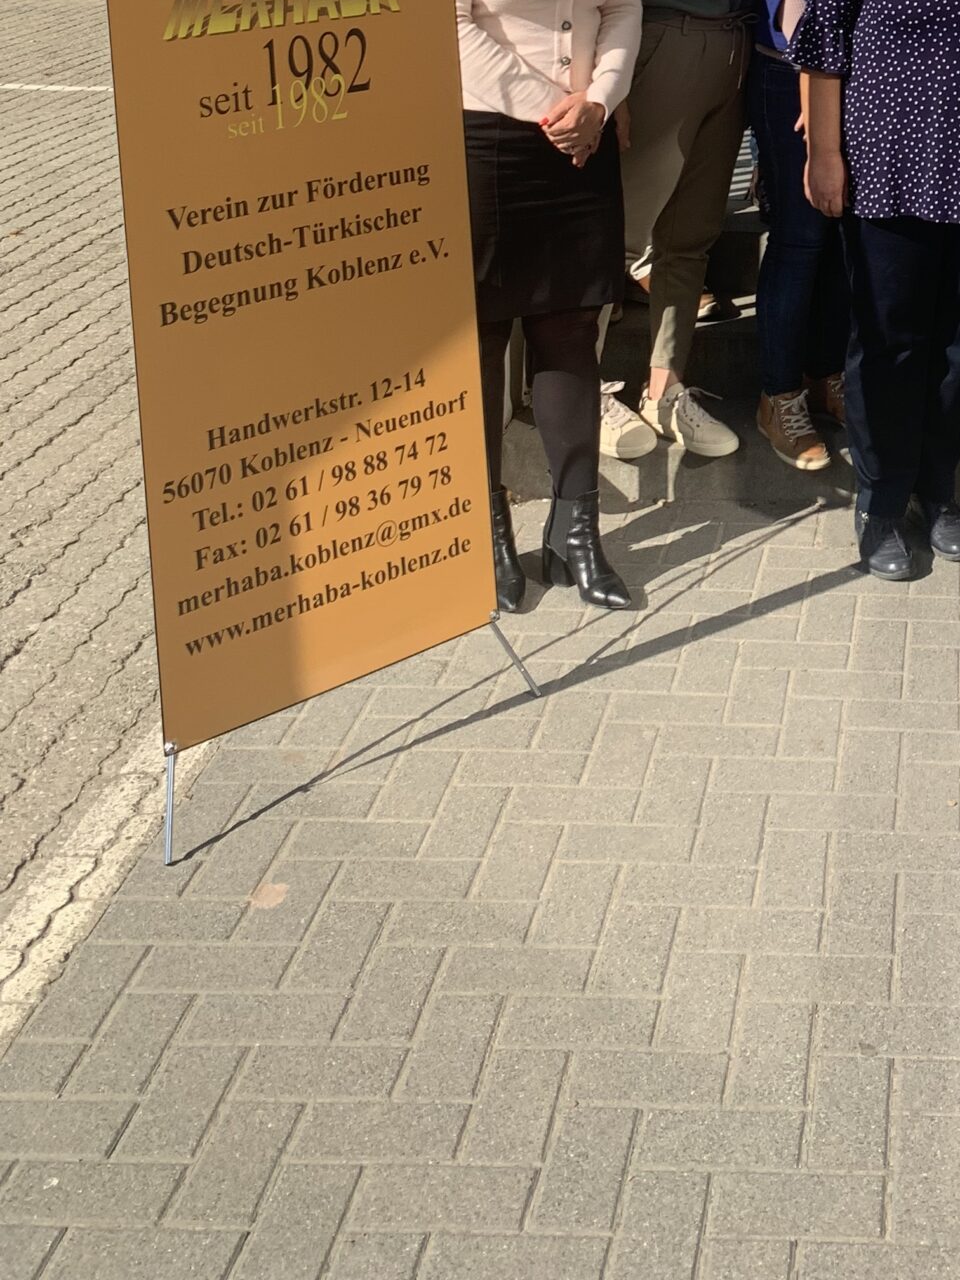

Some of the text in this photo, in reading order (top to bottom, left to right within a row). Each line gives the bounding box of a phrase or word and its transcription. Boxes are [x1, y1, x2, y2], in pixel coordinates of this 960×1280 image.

[199, 28, 371, 118] seit 1982
[227, 73, 348, 139] seit 1982
[166, 163, 430, 231] Verein zur Förderung
[181, 207, 422, 275] Deutsch-Türkischer
[159, 237, 449, 327] Begegnung Koblenz e.V.
[162, 463, 232, 504] 56070
[240, 435, 333, 479] Koblenz
[355, 391, 468, 442] Neuendorf
[206, 368, 426, 451] Handwerkstr. 12-14
[192, 500, 243, 531] Tel.:
[252, 487, 277, 511] 02
[286, 476, 309, 500] 61
[332, 461, 357, 486] 98
[364, 451, 388, 474] 88
[395, 441, 418, 465] 74
[425, 432, 448, 456] 72
[195, 539, 247, 571] Fax:
[256, 523, 282, 548] 02
[290, 512, 312, 537] 61
[336, 496, 360, 521] 98
[368, 486, 391, 510] 36
[398, 476, 422, 500] 79
[429, 466, 451, 489] 78
[178, 496, 472, 616] merhaba.koblenz@gmx.de
[185, 536, 472, 656] www.merhaba-koblenz.de
